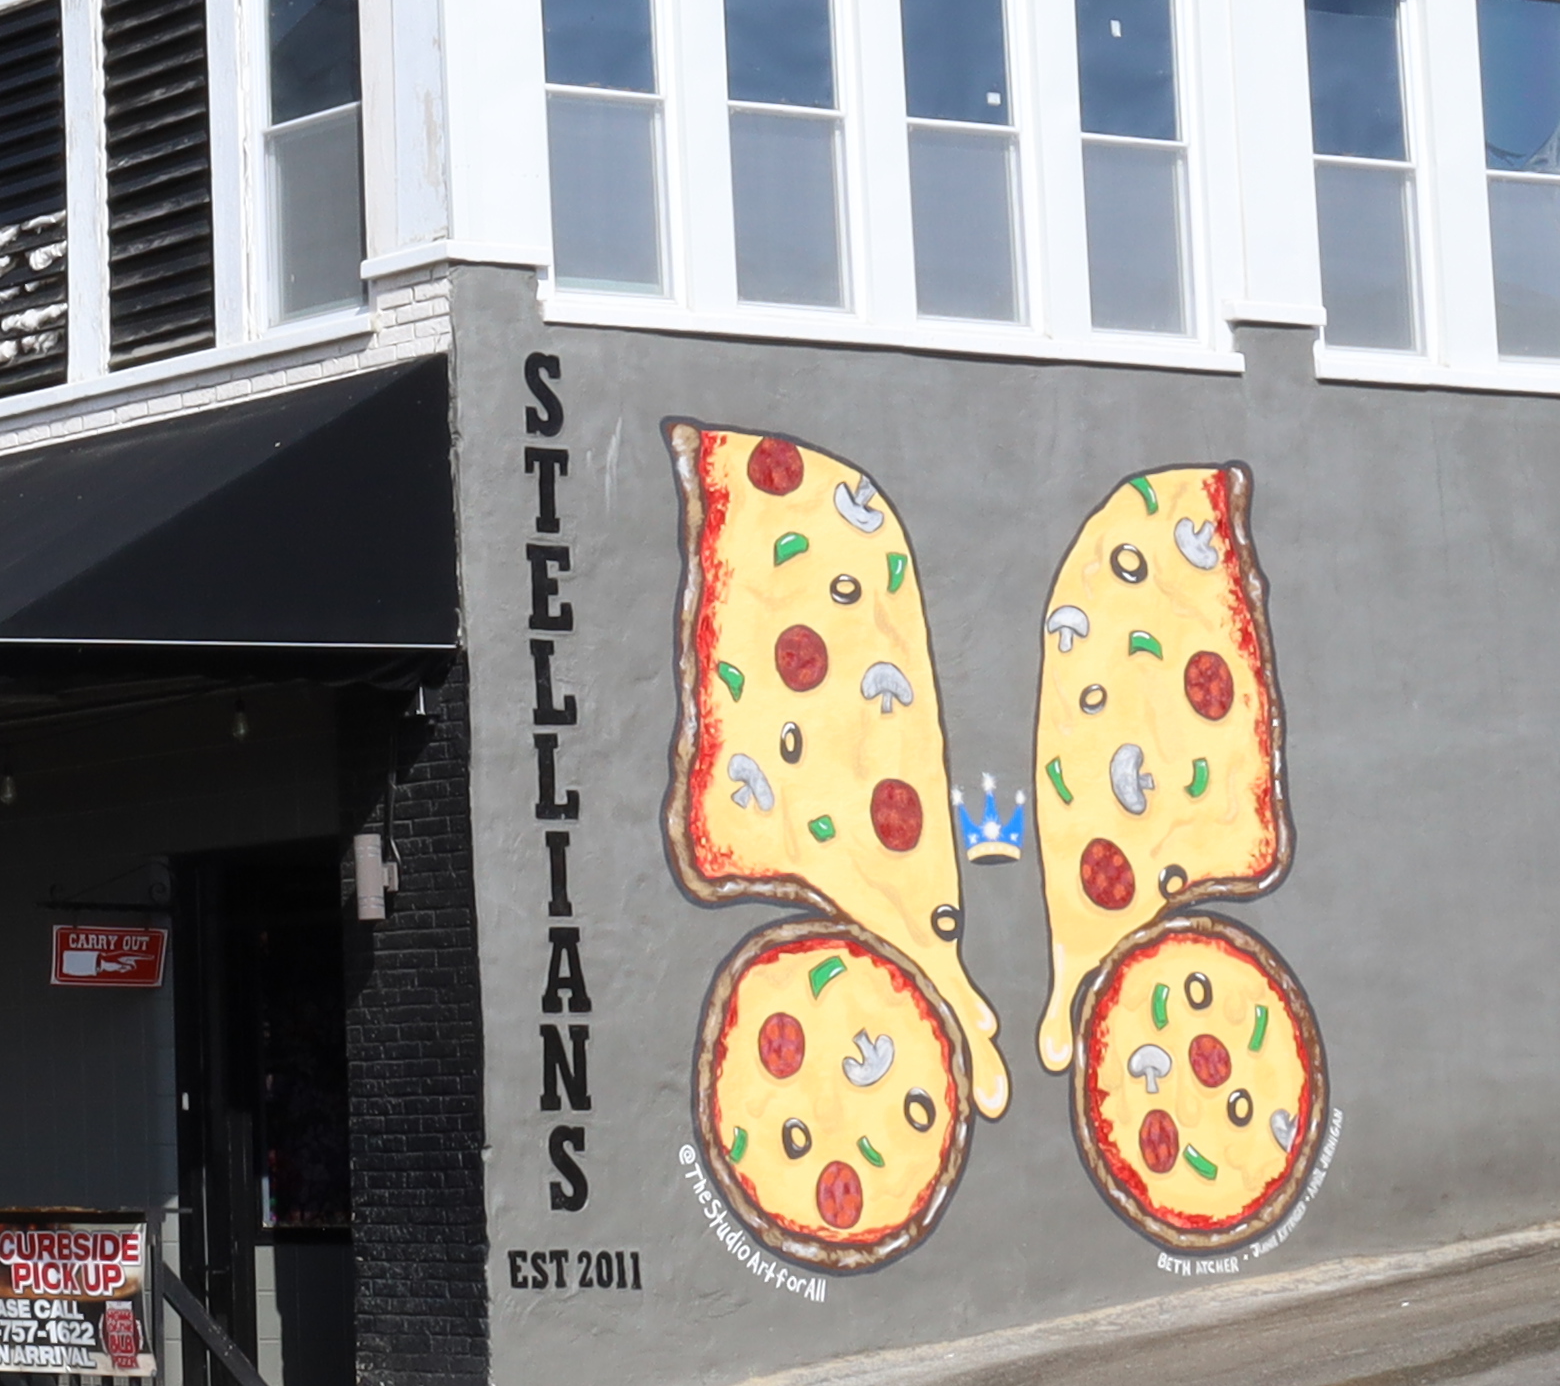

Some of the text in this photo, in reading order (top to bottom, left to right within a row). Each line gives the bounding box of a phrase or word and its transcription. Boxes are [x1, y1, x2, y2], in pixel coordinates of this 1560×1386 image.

[69, 933, 150, 951] CARRY OUT
[678, 1144, 827, 1303] @TheStudioArtforAll
[507, 1249, 643, 1291] EST 2011
[1156, 1252, 1191, 1276] BETH
[1195, 1256, 1240, 1275] ATCHER
[33, 1299, 85, 1321] CALL
[13, 1343, 98, 1368] ARRIVAL
